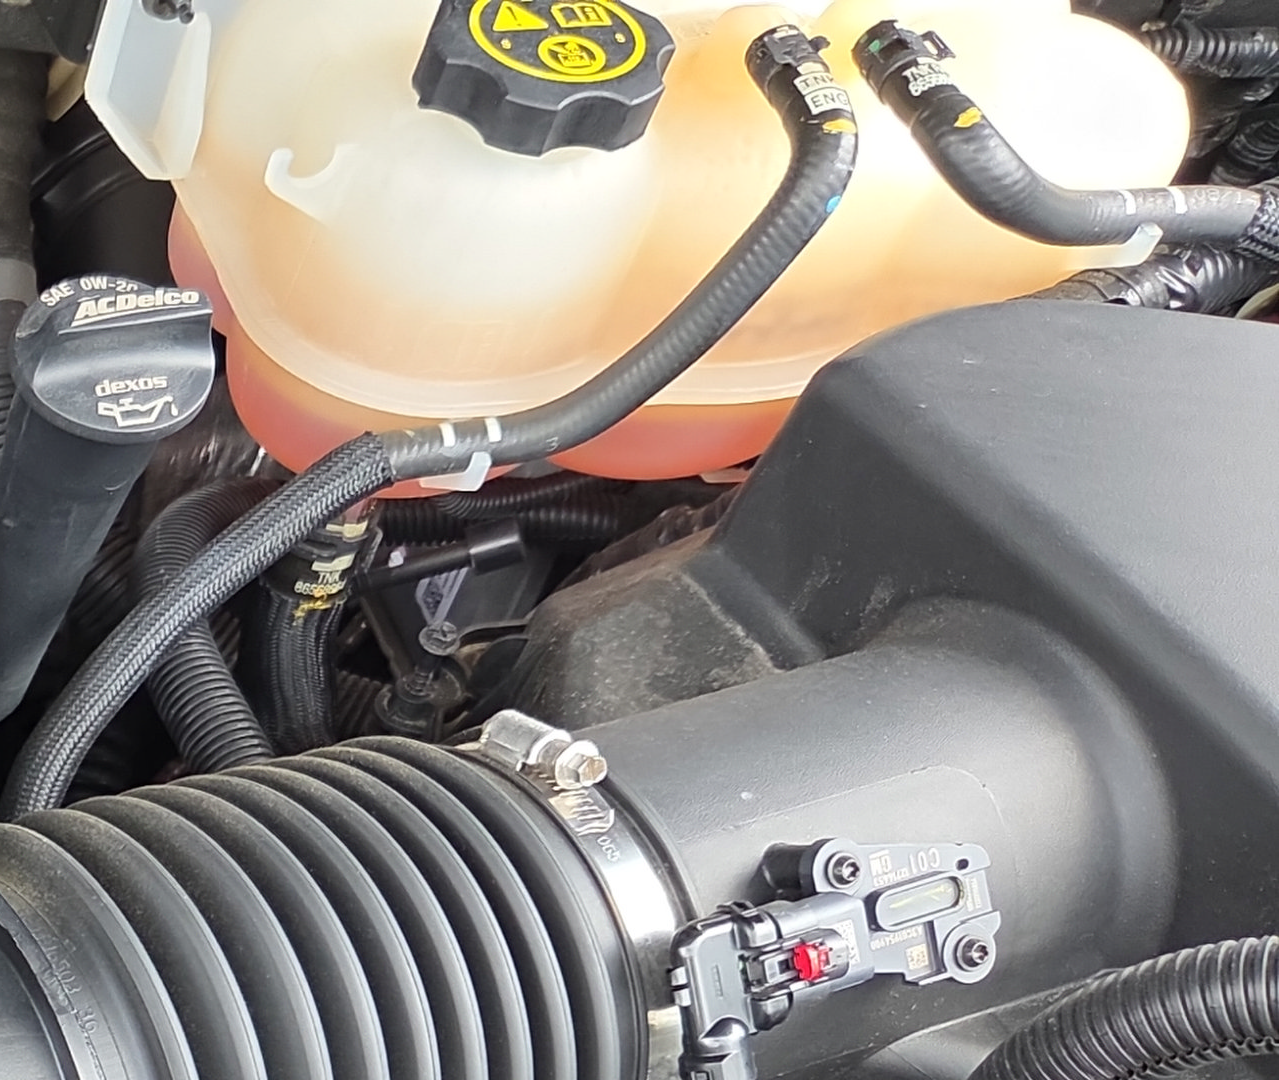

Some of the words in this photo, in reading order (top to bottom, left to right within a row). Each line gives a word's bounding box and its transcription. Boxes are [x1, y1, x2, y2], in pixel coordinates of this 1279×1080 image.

[40, 282, 75, 306] SAE
[74, 290, 200, 321] ACDelco
[94, 376, 168, 398] dexos
[870, 855, 892, 877] GM
